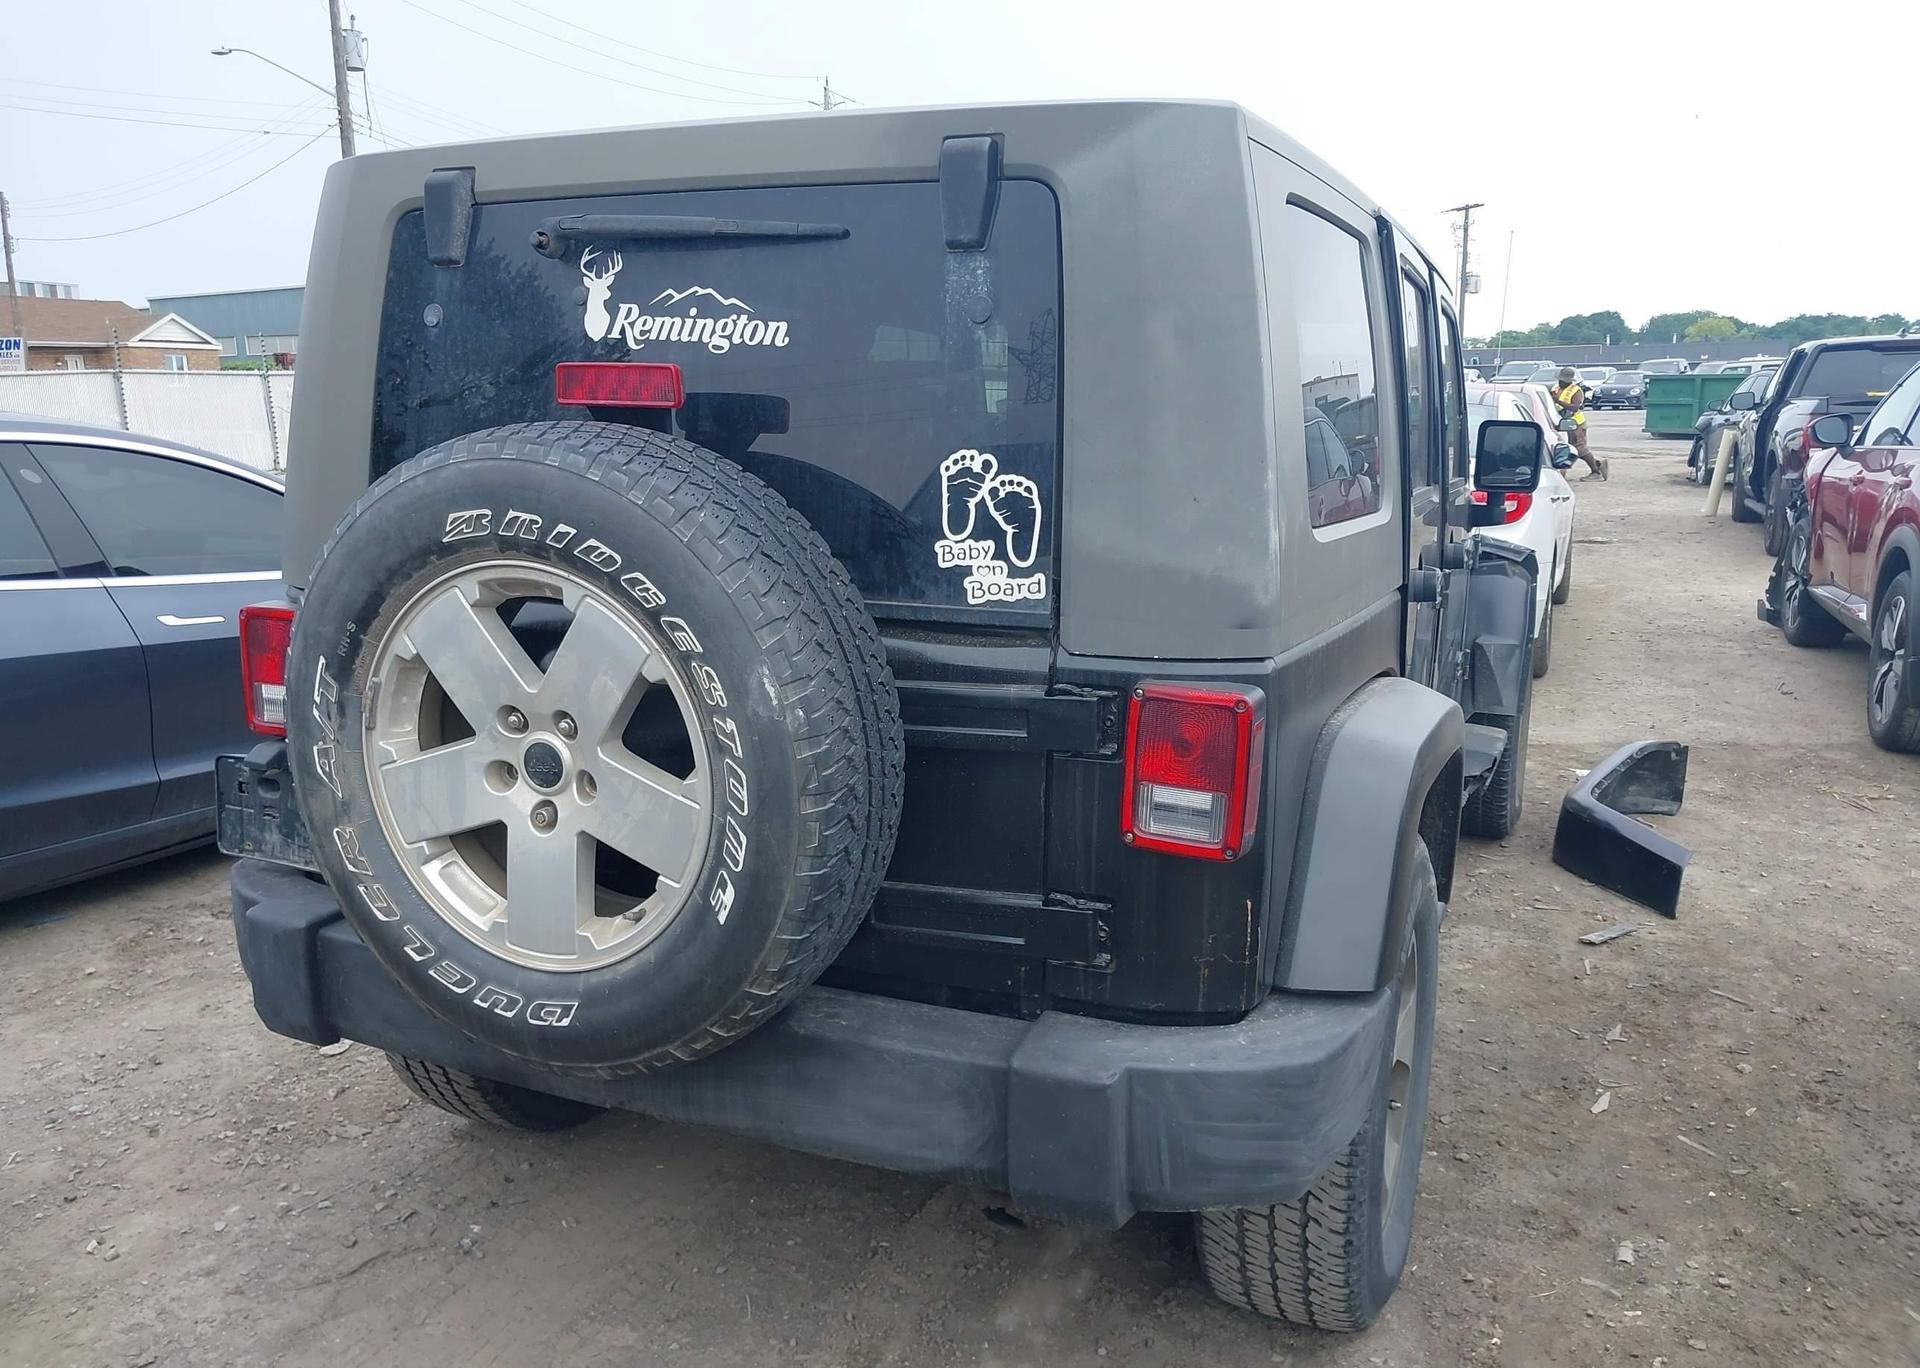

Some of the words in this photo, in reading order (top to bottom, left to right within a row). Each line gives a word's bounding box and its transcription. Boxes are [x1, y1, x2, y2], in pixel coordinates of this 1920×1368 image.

[608, 303, 790, 354] Remington
[938, 543, 991, 563] Baby
[967, 578, 1042, 600] Board
[312, 655, 343, 799] A/T
[442, 509, 748, 925] BRIDGESTONE
[333, 826, 579, 1027] DUELER
